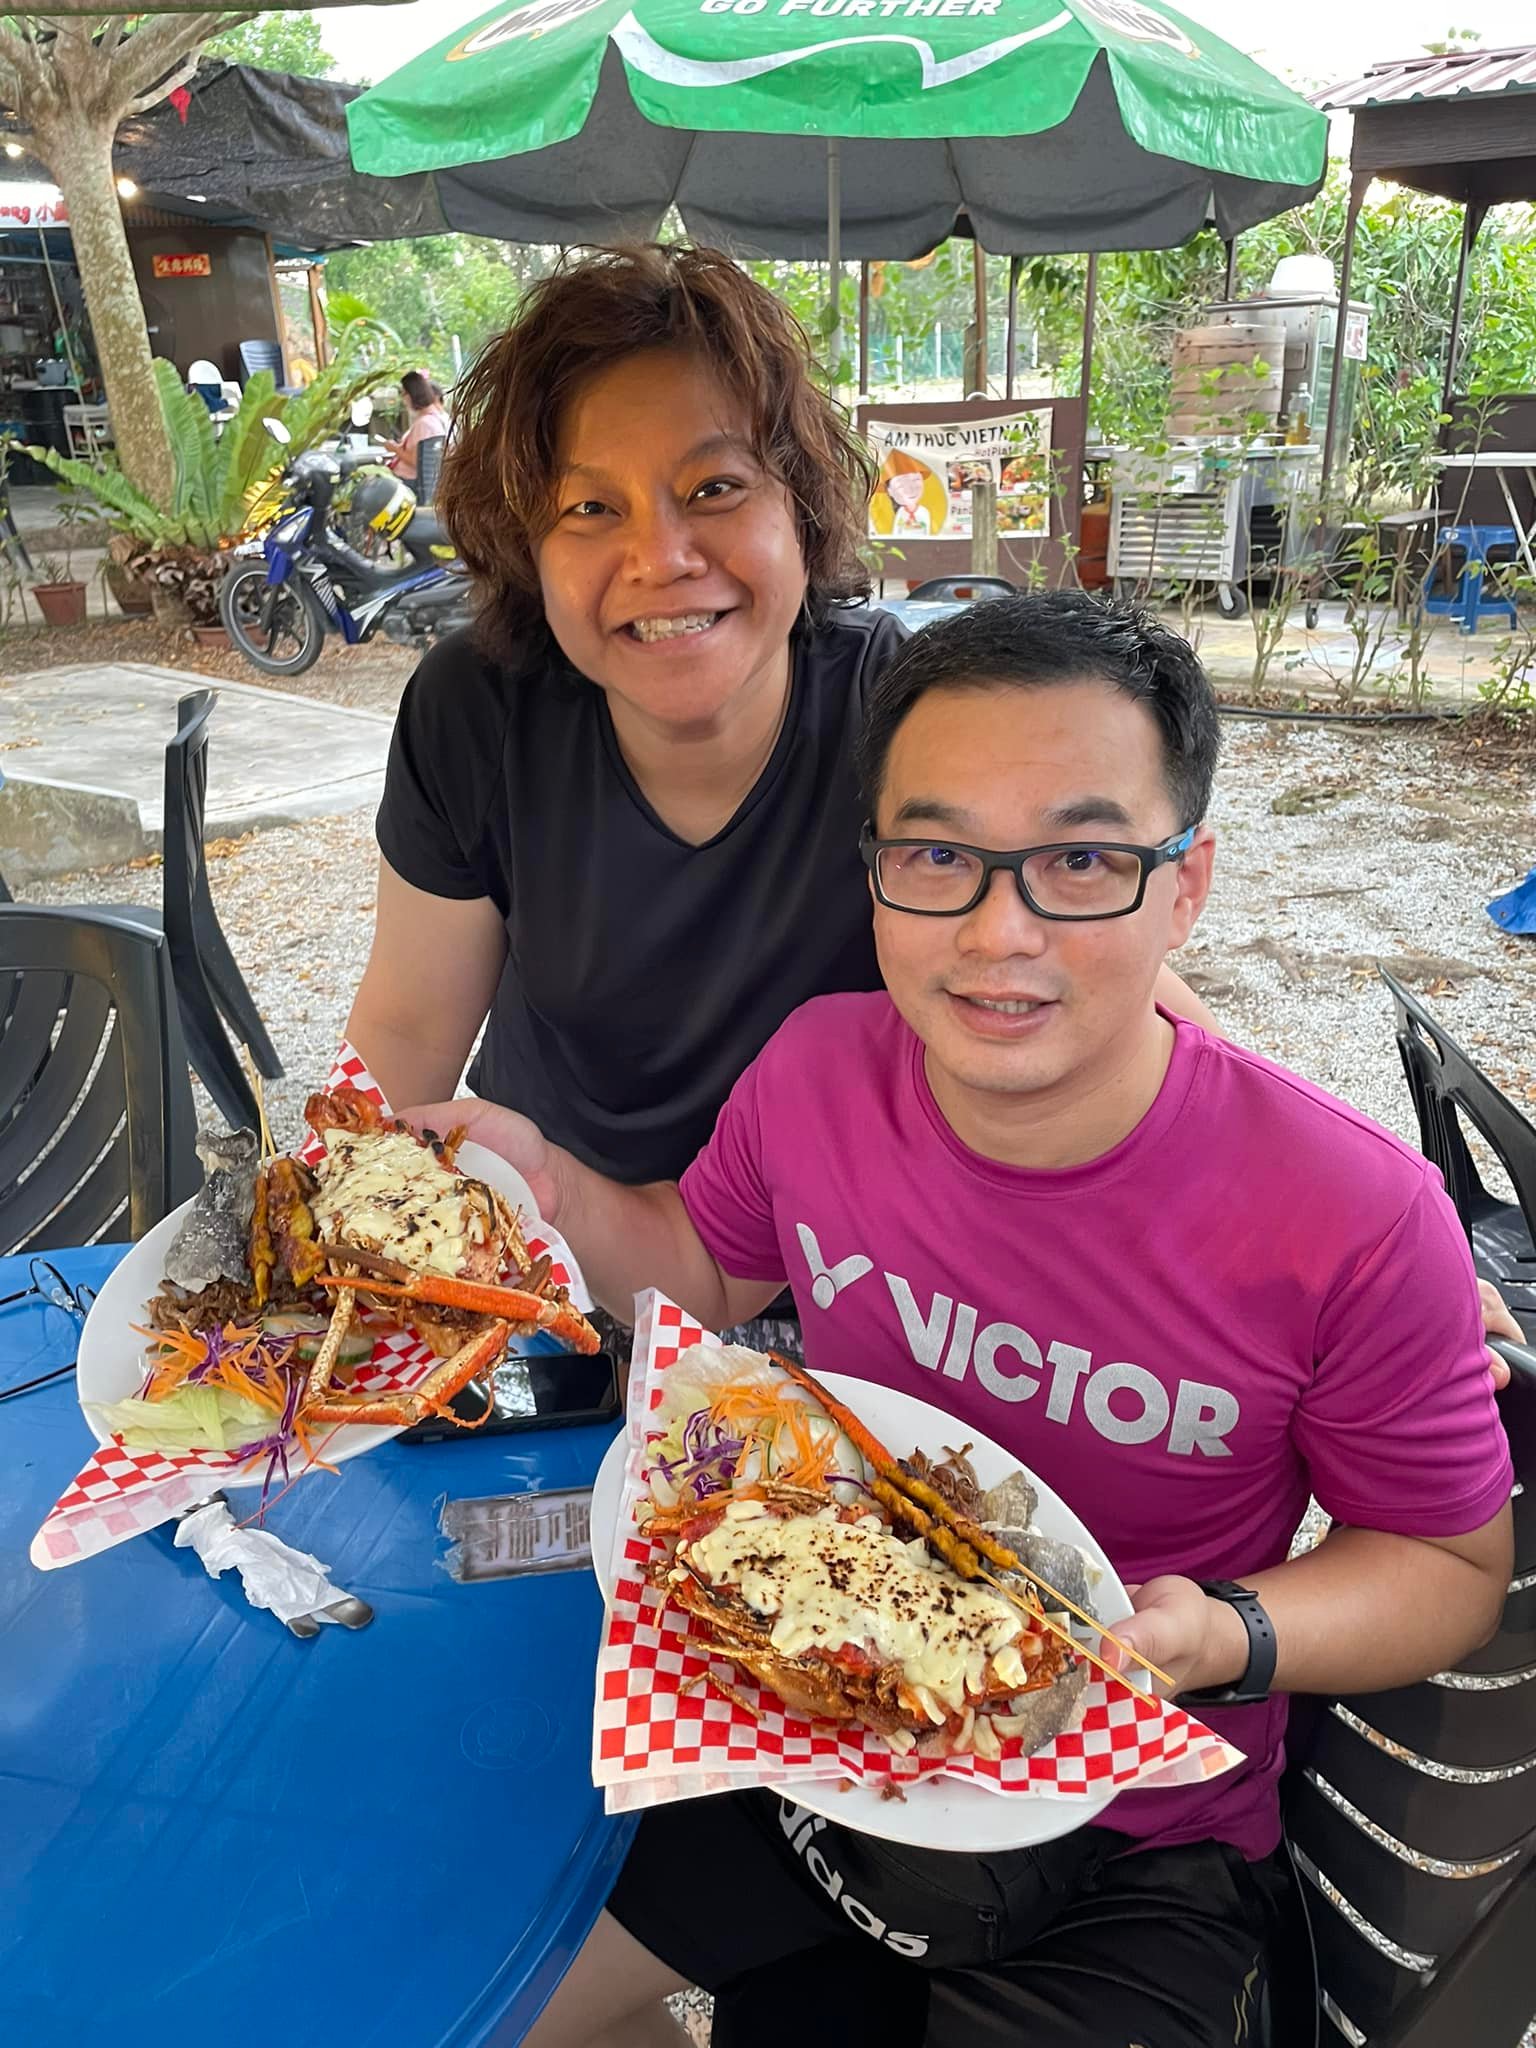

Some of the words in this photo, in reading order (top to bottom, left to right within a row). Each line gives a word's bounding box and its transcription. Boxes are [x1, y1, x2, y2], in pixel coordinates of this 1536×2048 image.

[700, 0, 767, 14] GO
[777, 0, 1002, 16] FURTHER
[883, 1271, 1240, 1457] VICTOR
